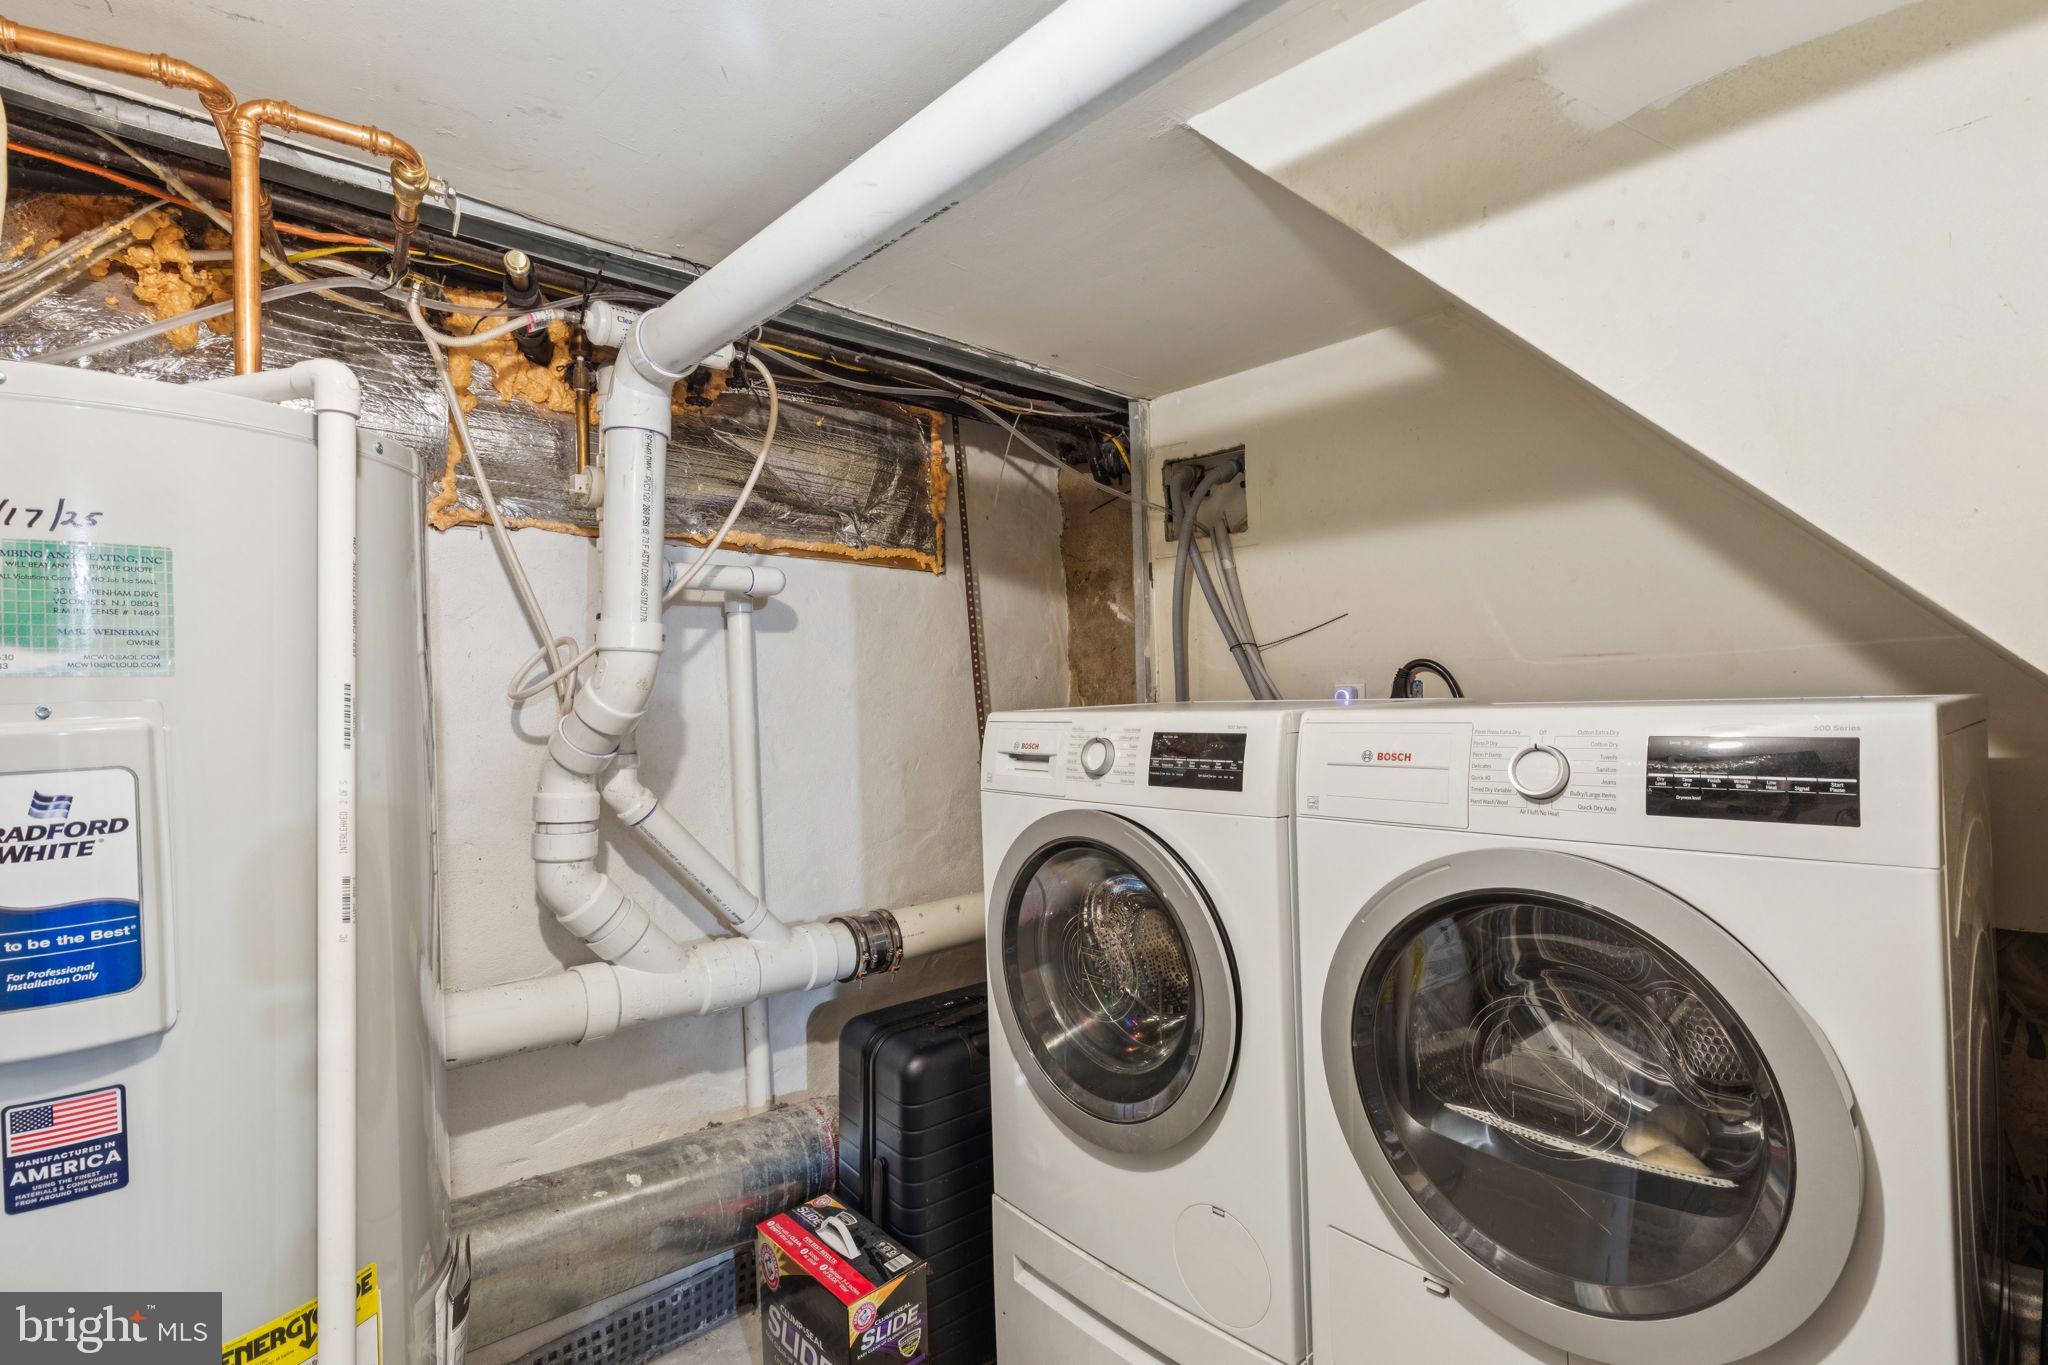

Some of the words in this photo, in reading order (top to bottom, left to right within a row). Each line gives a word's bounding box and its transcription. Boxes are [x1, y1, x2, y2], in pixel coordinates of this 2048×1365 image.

[642, 504, 651, 517] 260
[642, 517, 650, 527] PSI
[141, 556, 163, 565] INC
[641, 550, 650, 568] ASTM
[640, 588, 649, 607] ASTM
[94, 629, 159, 637] WEINERMAN
[1021, 742, 1039, 750] BOSCH
[1377, 752, 1412, 761] BOSCH
[1570, 790, 1600, 798] Bulky/Large
[0, 840, 96, 864] WHITE
[4, 942, 22, 952] to
[27, 939, 51, 950] be
[56, 934, 85, 946] the
[90, 925, 131, 941] Best
[6, 973, 25, 982] For
[26, 962, 95, 980] Professional
[6, 977, 70, 992] Installation
[72, 971, 99, 982] Only
[15, 1144, 102, 1169] MANUFACTURED
[104, 1141, 116, 1149] IN
[10, 1149, 122, 1187] AMERICA
[15, 1187, 58, 1200] MATERIALS
[66, 1172, 118, 1189] COMPONENTS
[32, 1180, 56, 1191] USING
[58, 1177, 73, 1185] THE
[74, 1170, 101, 1181] FINEST
[15, 1198, 38, 1207] FROM
[39, 1190, 72, 1202] AROUND
[74, 1186, 89, 1194] THE
[91, 1178, 118, 1189] WORLD
[812, 1242, 822, 1252] BEST
[780, 1304, 803, 1330] CLUMP
[805, 1328, 826, 1351] SEAL
[861, 1304, 920, 1351] SLIDE
